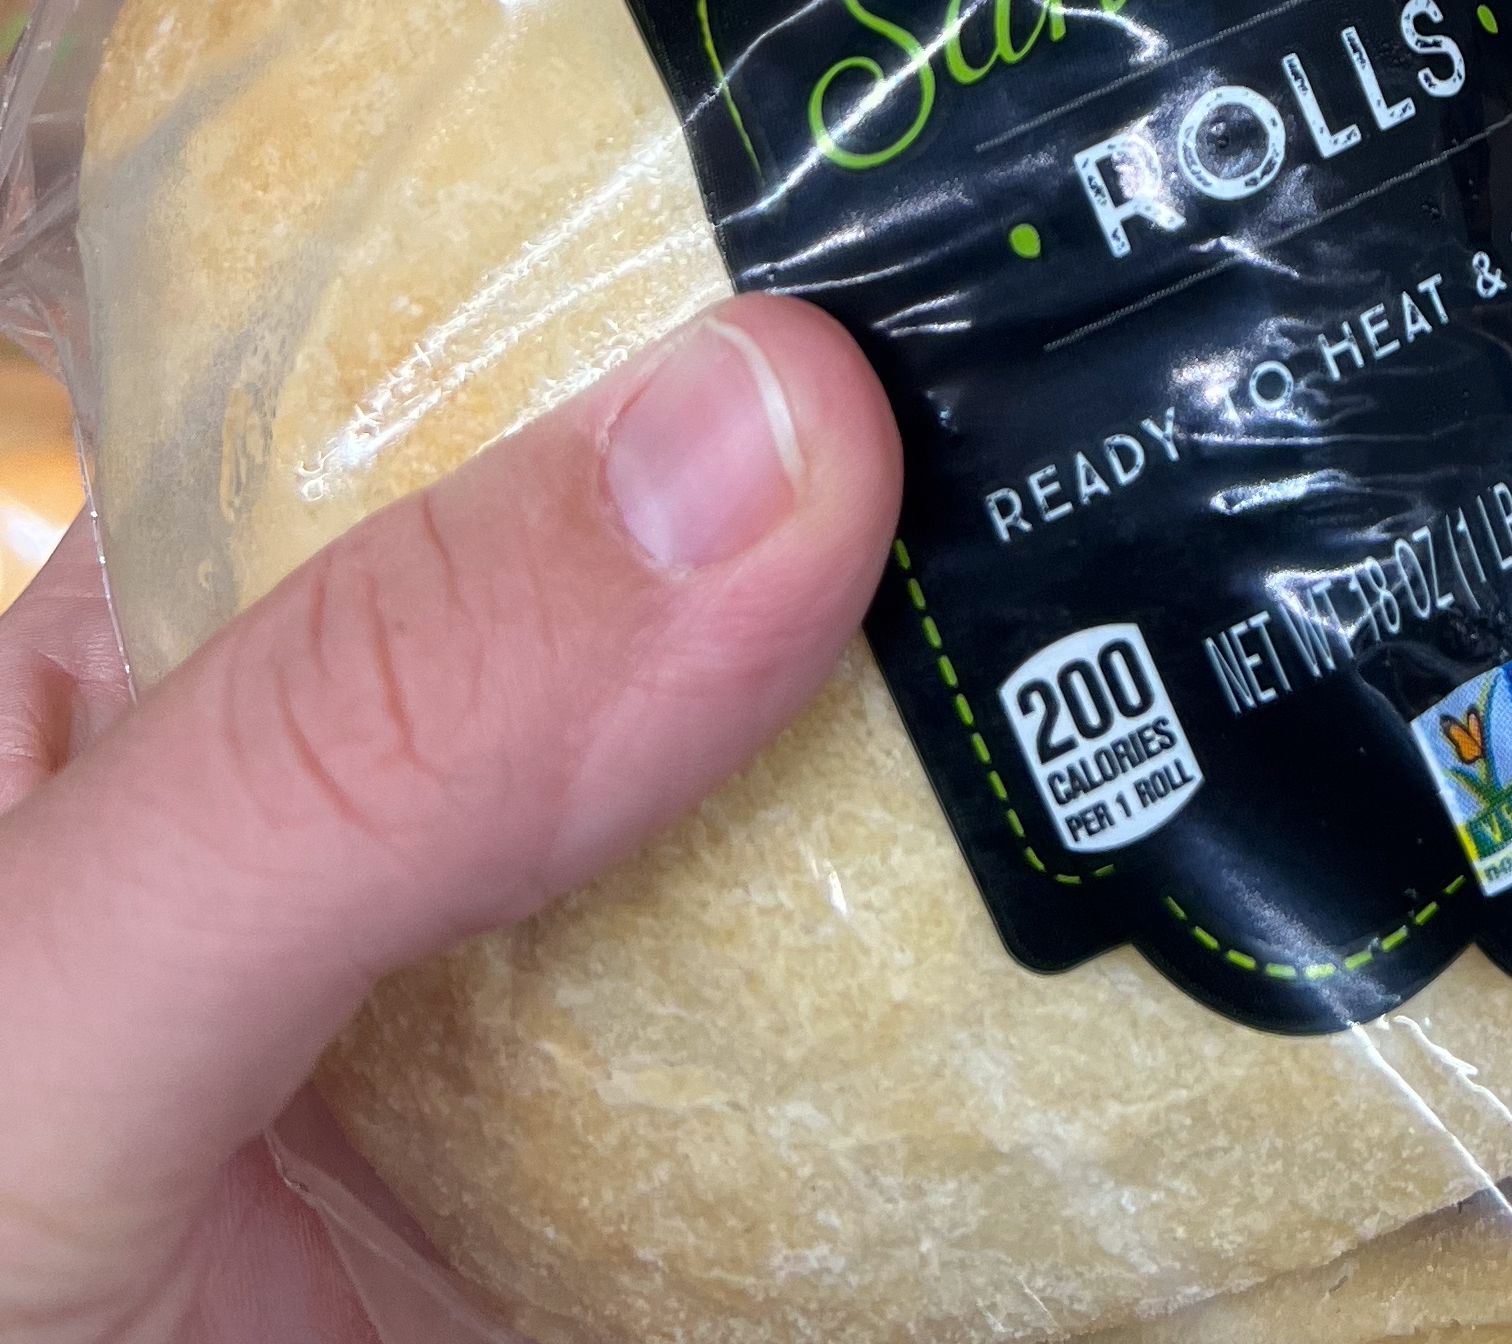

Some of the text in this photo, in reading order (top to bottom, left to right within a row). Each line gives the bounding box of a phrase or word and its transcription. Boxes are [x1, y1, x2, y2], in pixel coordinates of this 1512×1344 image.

[984, 406, 1184, 544] READY
[1208, 359, 1295, 430] TO
[1317, 273, 1450, 381] HEAT
[1471, 250, 1507, 299] &
[1202, 610, 1294, 716] NET
[1277, 578, 1354, 679] WT
[1348, 555, 1401, 643] 18
[1394, 524, 1455, 620] OZ
[1445, 506, 1488, 611] (1
[1015, 636, 1157, 766] 200
[1046, 714, 1178, 807] CALORIES
[1064, 756, 1197, 843] PER 1 ROLL
